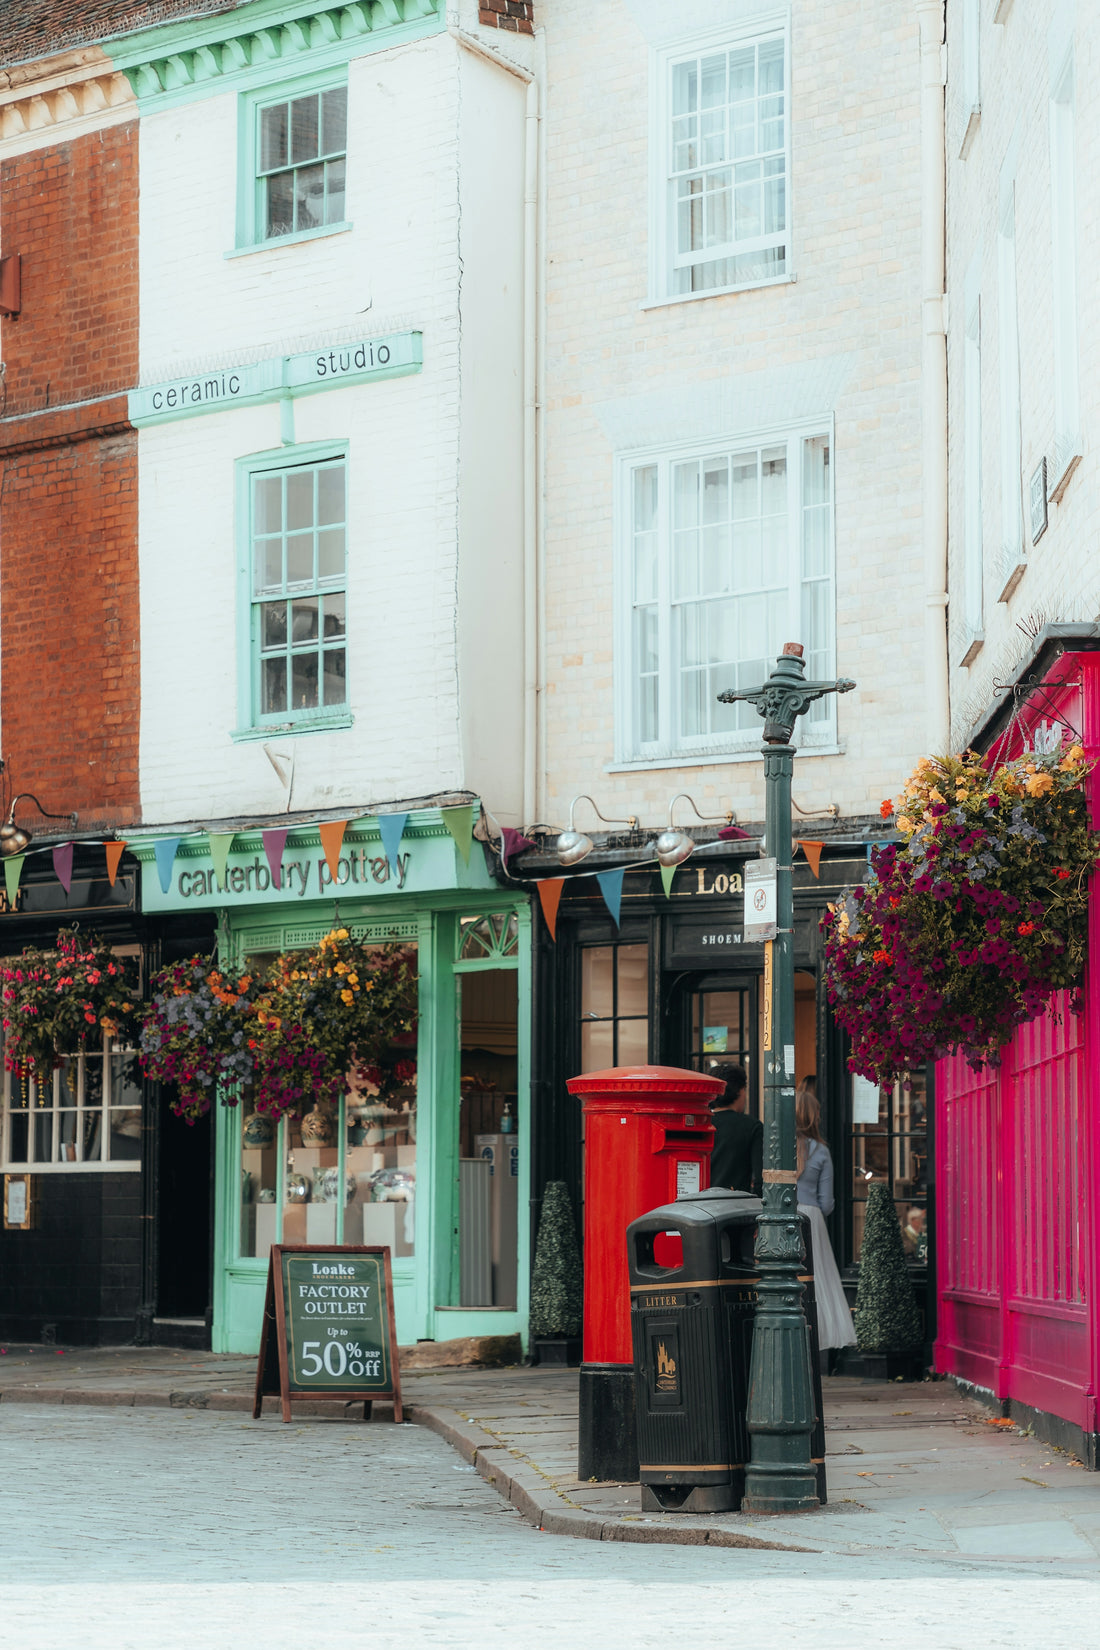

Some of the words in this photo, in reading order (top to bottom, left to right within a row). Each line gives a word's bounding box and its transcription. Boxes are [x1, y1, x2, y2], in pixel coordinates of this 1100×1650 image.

[152, 374, 241, 410] ceramic
[316, 343, 391, 377] studio
[695, 867, 744, 895] Loa
[312, 1263, 355, 1275] Loake
[299, 1286, 370, 1298] FACTORY
[645, 1296, 677, 1307] LITTER
[304, 1302, 366, 1314] OUTLET
[327, 1327, 339, 1338] Up
[340, 1328, 349, 1336] to
[348, 1360, 381, 1377] Off
